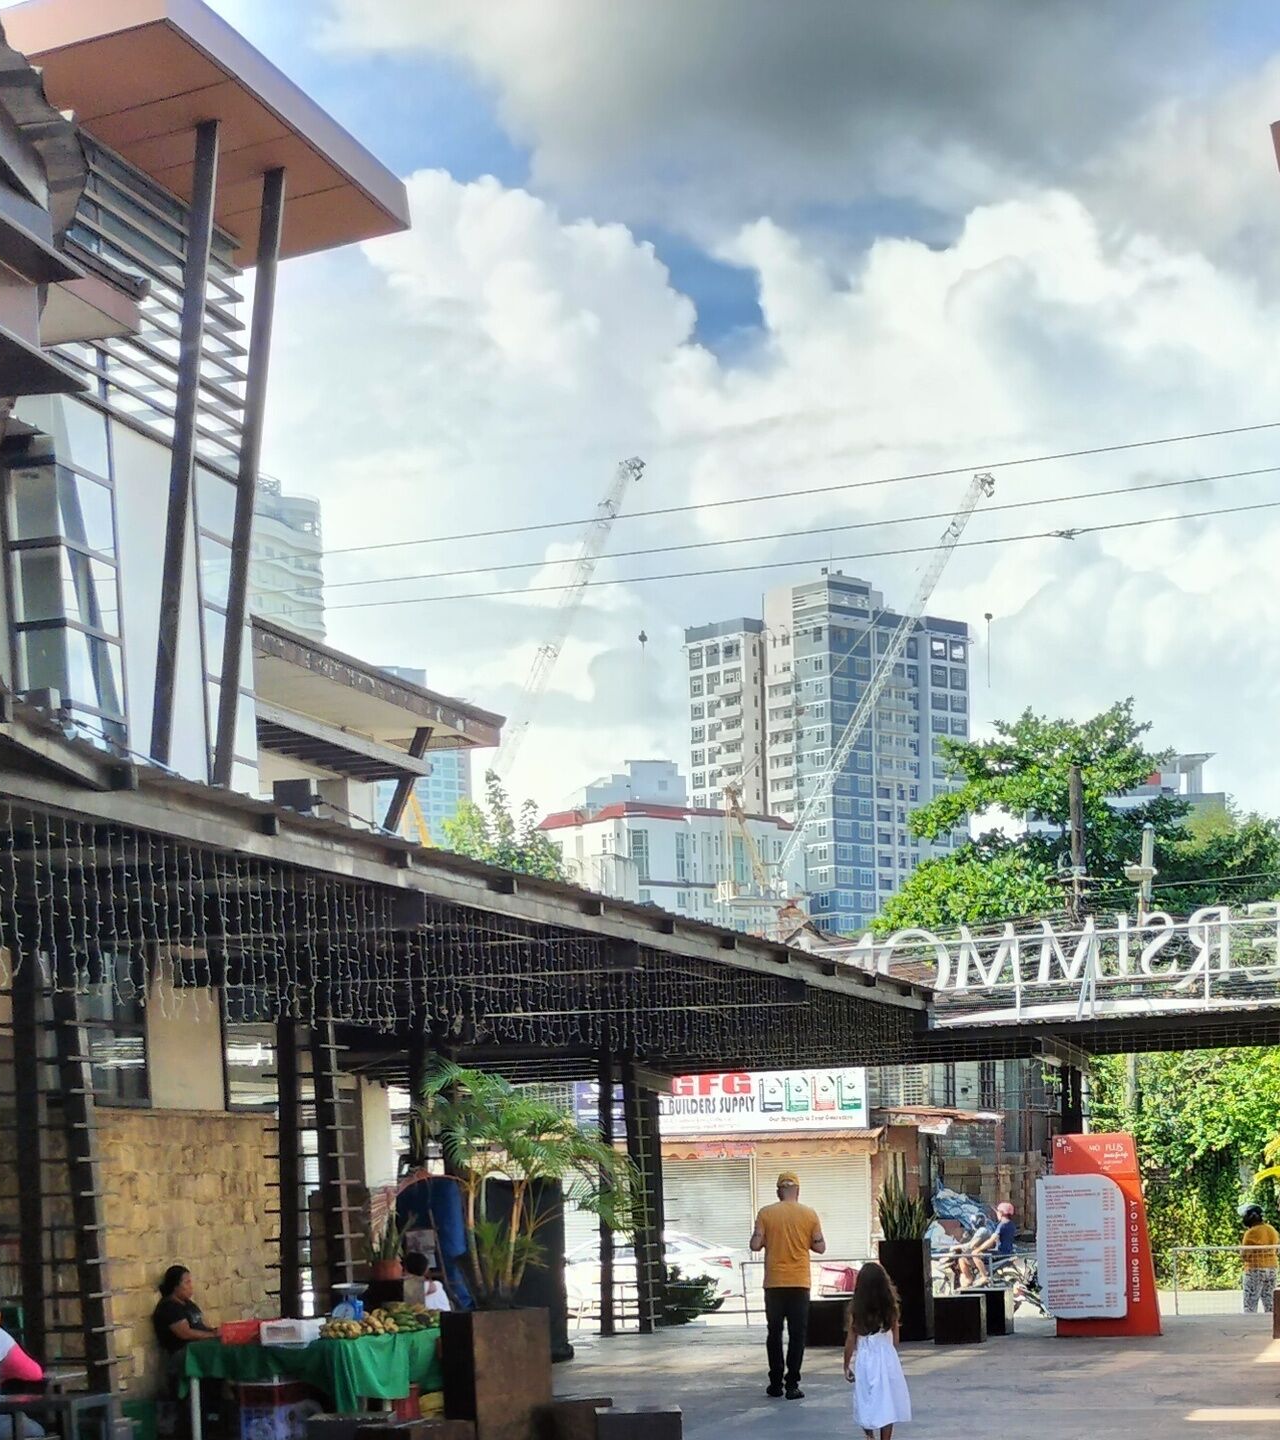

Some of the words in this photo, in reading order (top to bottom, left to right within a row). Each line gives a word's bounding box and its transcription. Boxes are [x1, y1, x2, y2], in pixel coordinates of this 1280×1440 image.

[671, 1072, 752, 1096] GFG
[670, 1096, 716, 1115] BUILDERS
[720, 1095, 755, 1113] SUPPLY
[1130, 1199, 1139, 1254] DIRCOY
[1132, 1258, 1140, 1303] BUILDING
